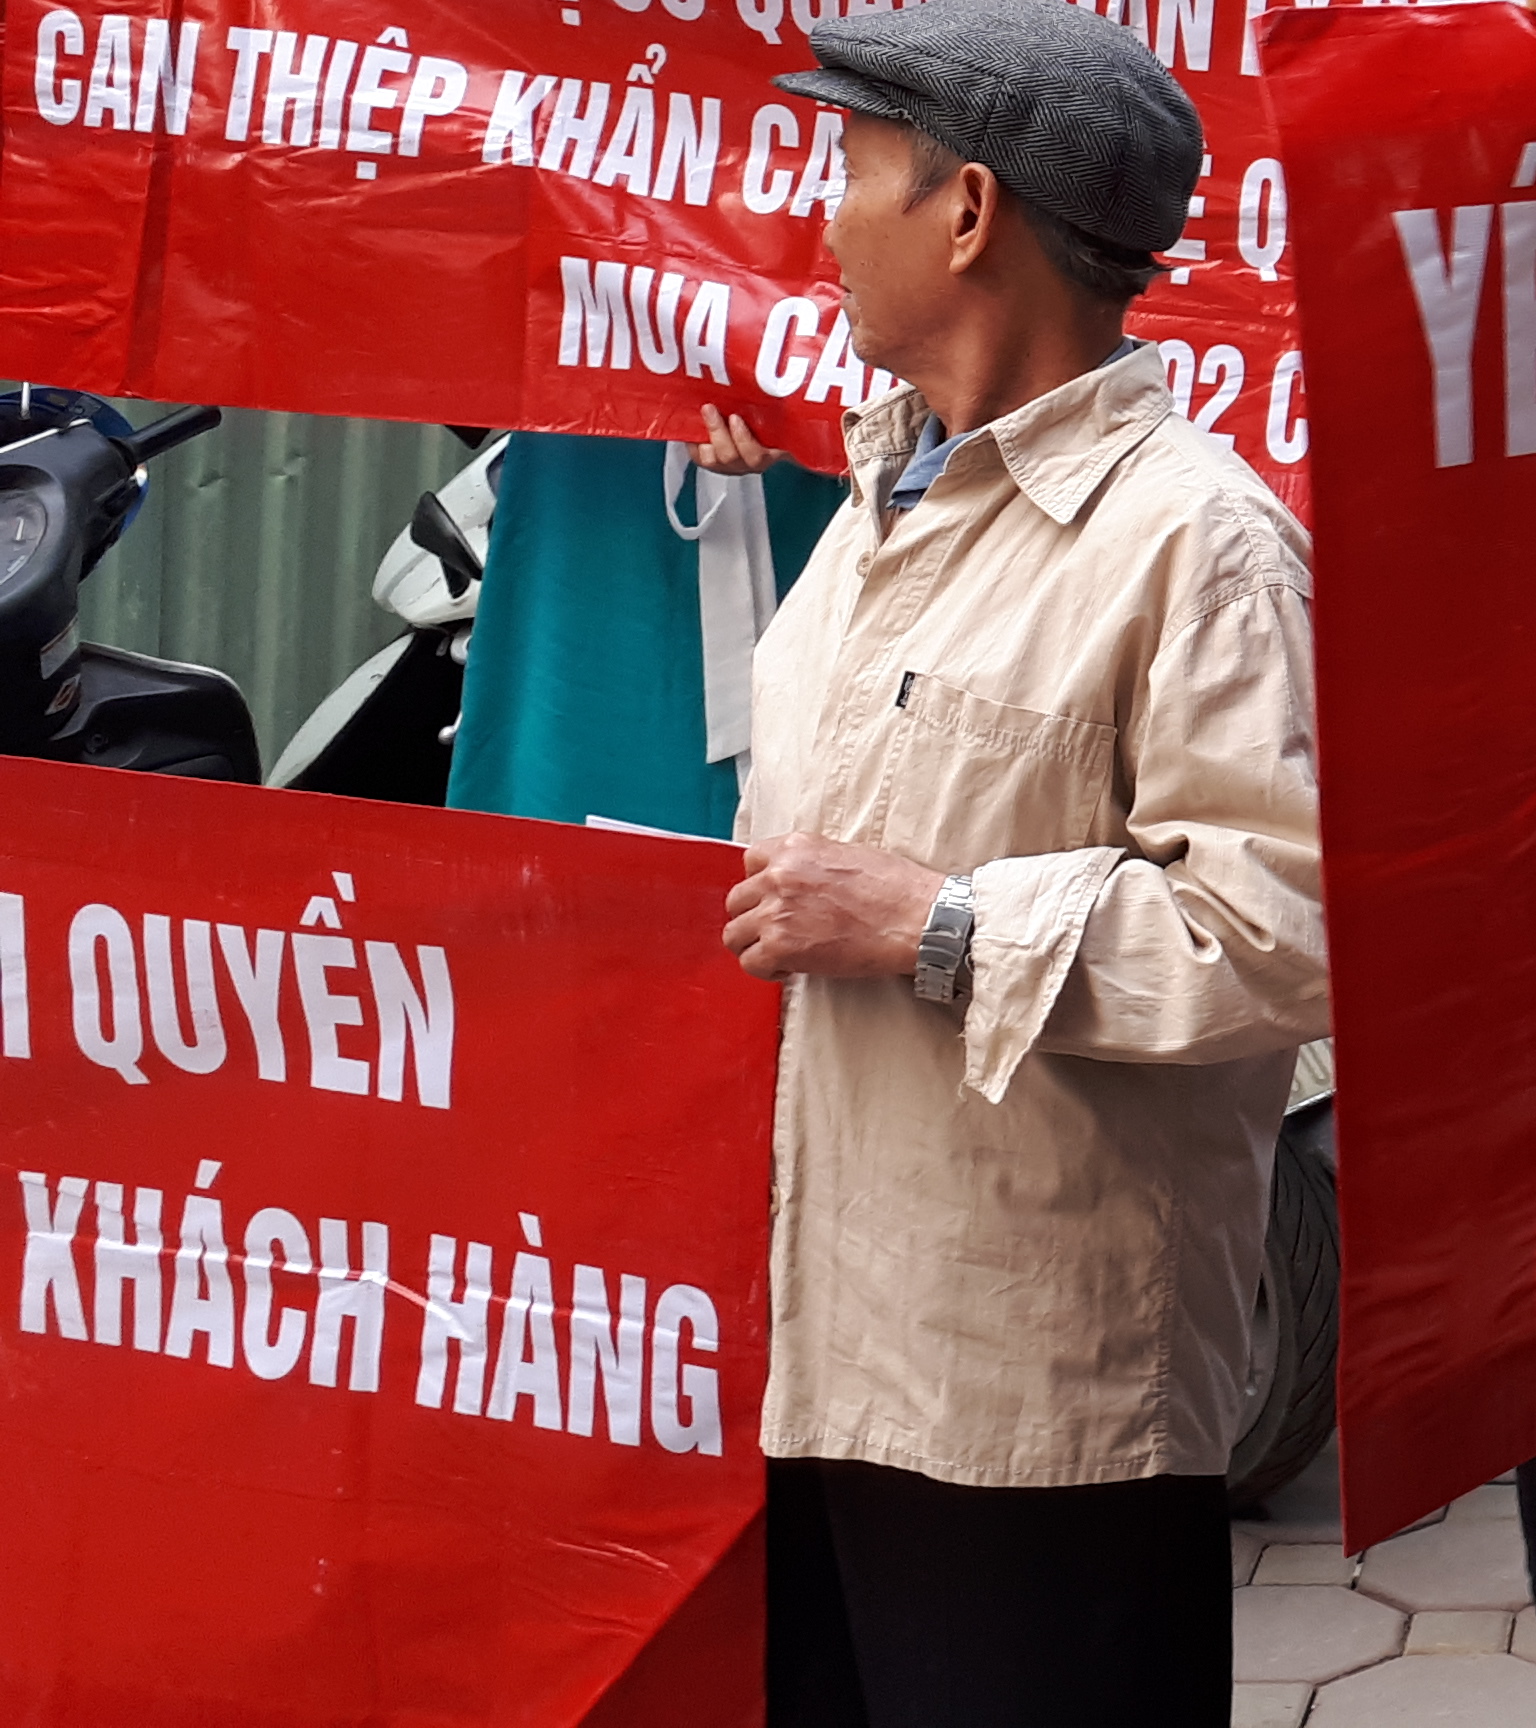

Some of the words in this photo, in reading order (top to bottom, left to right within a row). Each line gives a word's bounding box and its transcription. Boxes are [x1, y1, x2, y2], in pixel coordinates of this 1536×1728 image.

[34, 9, 200, 136] CAN
[225, 25, 468, 180] THIỆP
[482, 42, 722, 206] KHẨN
[558, 255, 731, 385] MUA
[69, 872, 455, 1109] QUYỀN
[19, 1159, 389, 1392] KHÁCH
[415, 1212, 723, 1457] HÀNG
